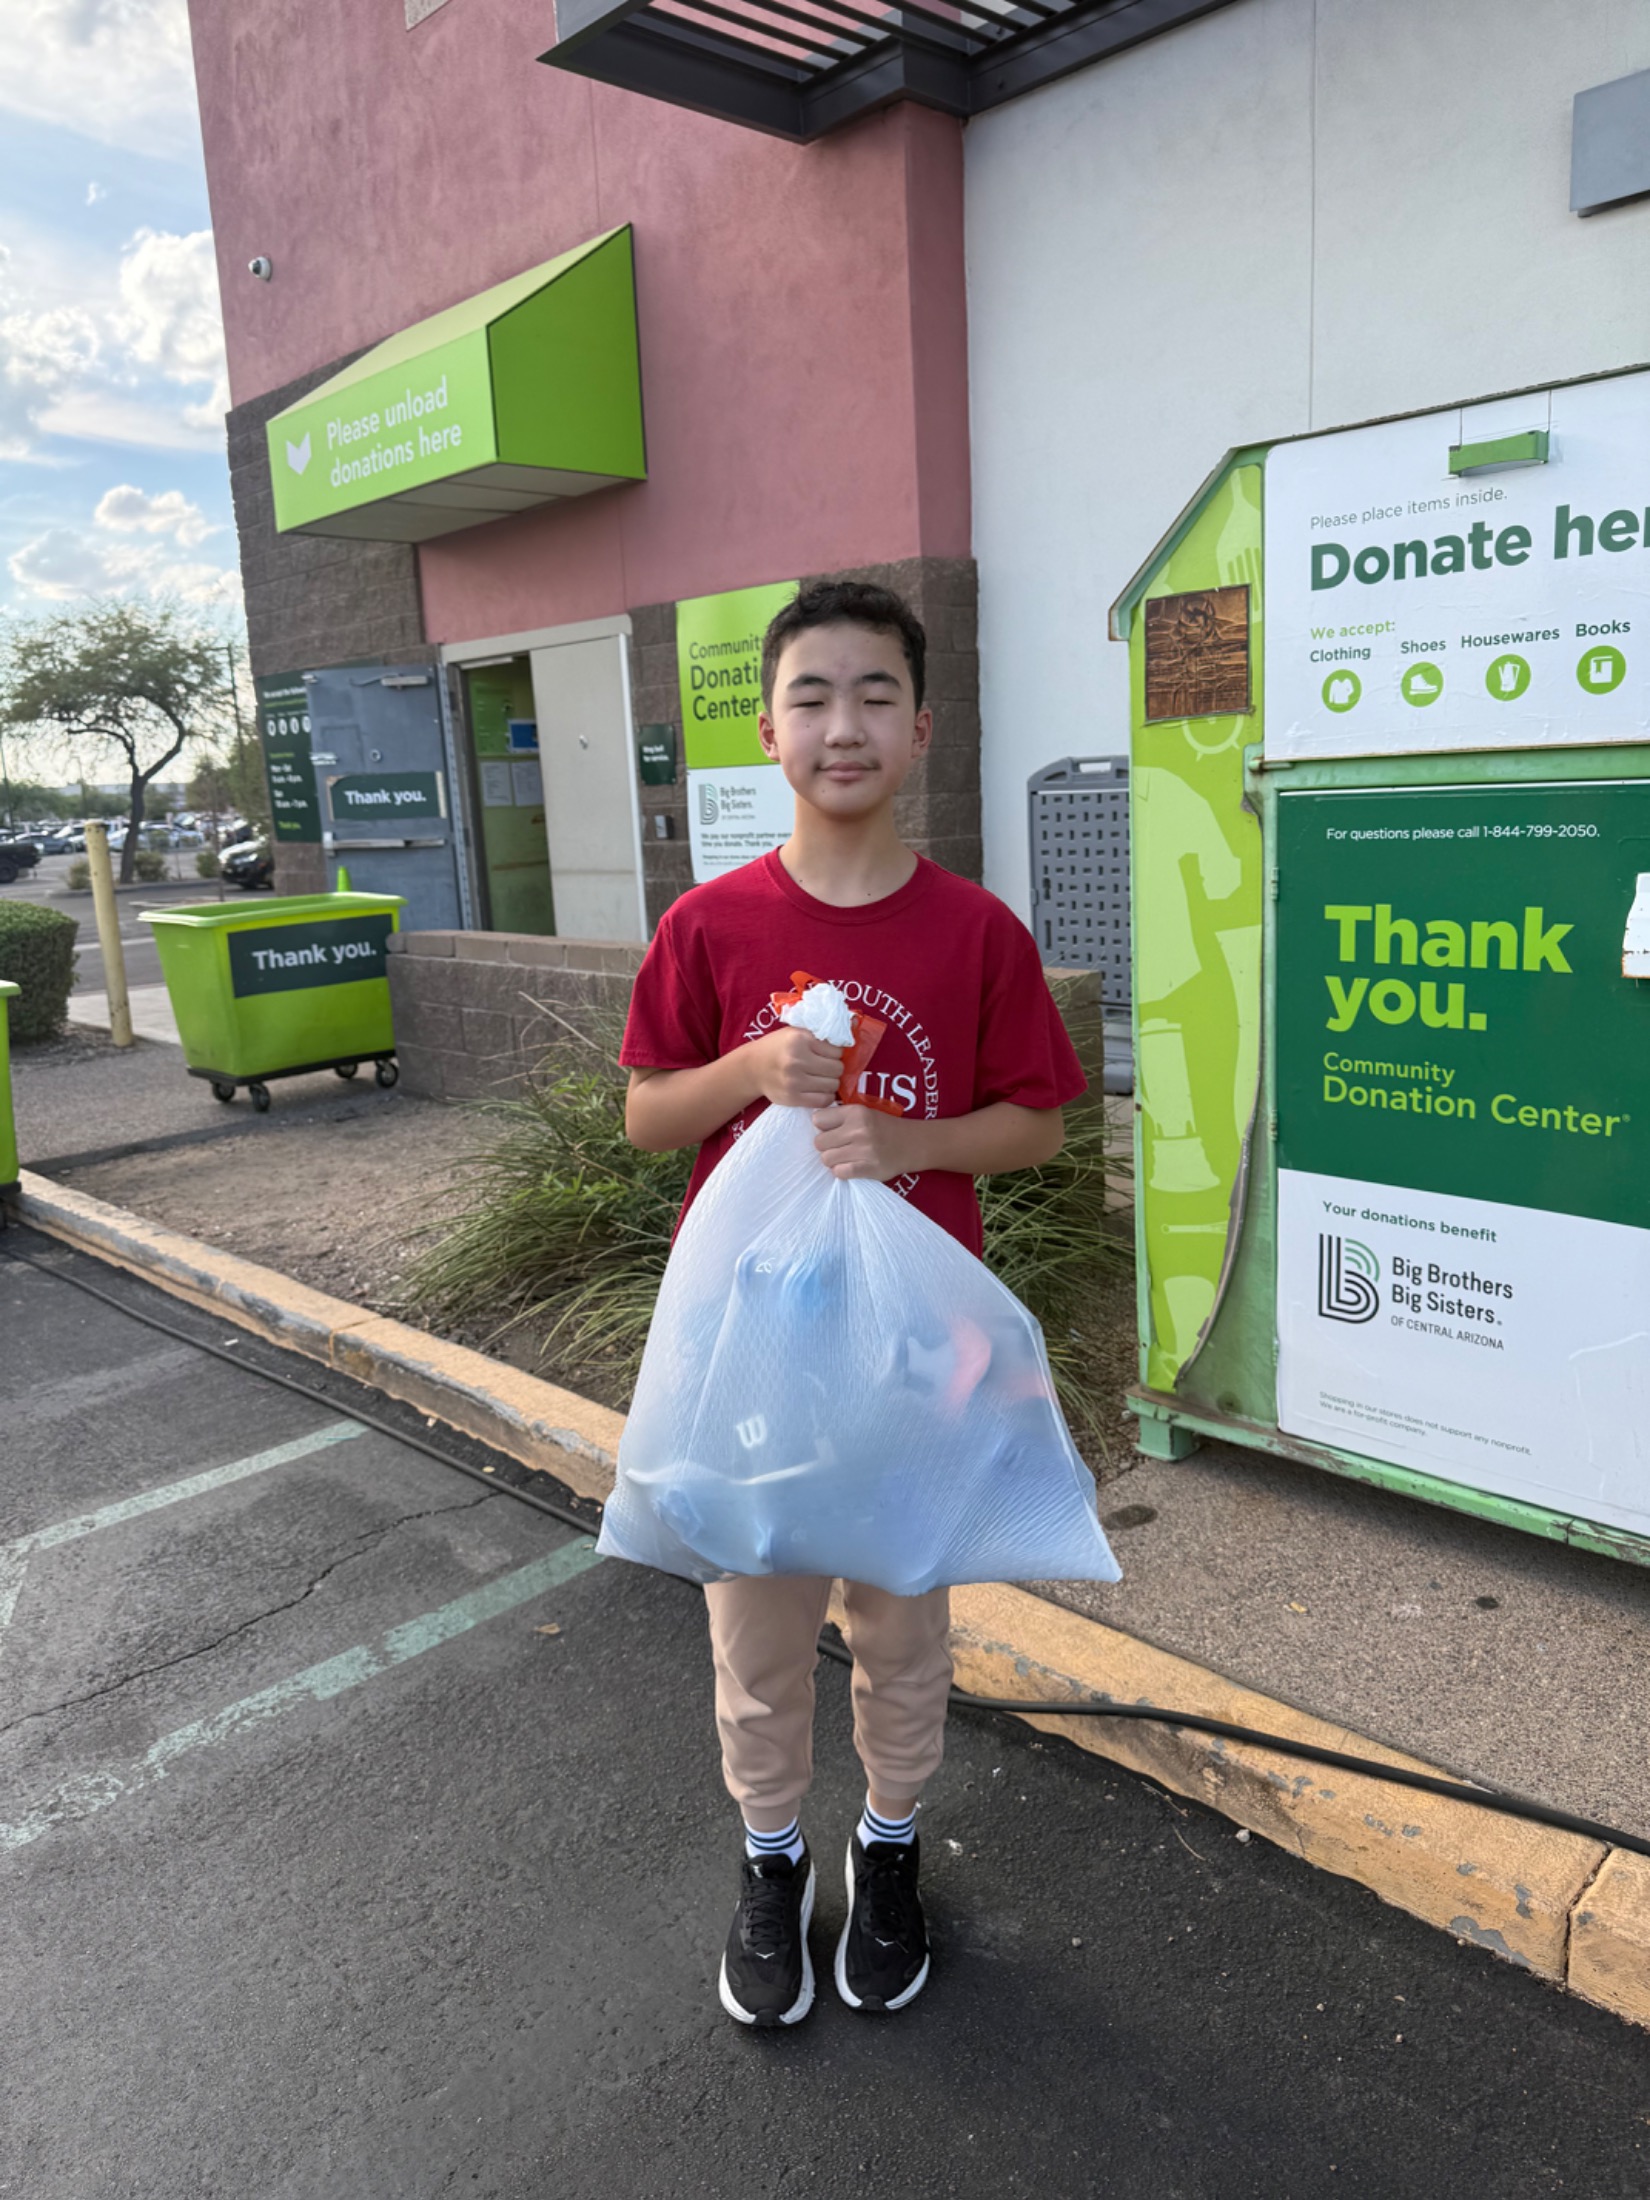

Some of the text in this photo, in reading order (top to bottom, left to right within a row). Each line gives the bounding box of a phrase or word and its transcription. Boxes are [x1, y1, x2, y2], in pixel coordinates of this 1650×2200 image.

[327, 374, 449, 451] Please unload
[330, 423, 462, 488] donations here
[1310, 486, 1508, 530] Please place items inside.
[1311, 503, 1650, 591] Donate he
[1310, 620, 1396, 640] We accept:
[1461, 628, 1560, 648] Housewares
[1575, 619, 1631, 637] Books
[688, 634, 763, 660] Communit
[1310, 646, 1371, 663] Clothing
[1400, 639, 1447, 655] Shoes
[690, 658, 759, 691] Donati
[693, 695, 760, 721] Center
[344, 790, 427, 805] Thank you.
[1326, 824, 1600, 841] For questions please call 1-844-799-2050.
[252, 942, 377, 970] Thank you.
[1324, 904, 1575, 974] Thank
[1324, 975, 1488, 1033] you.
[827, 979, 912, 1029] YOUTH
[906, 1024, 939, 1120] LEADER
[1323, 1052, 1455, 1088] Community
[1323, 1075, 1475, 1120] Donation
[1323, 1201, 1497, 1243] Your donations benefit
[1392, 1256, 1514, 1300] Big Brothers
[1391, 1284, 1422, 1314] Big
[1390, 1315, 1504, 1351] OF CENTRAL ARIZONA
[1319, 1400, 1333, 1411] We
[1334, 1405, 1346, 1414] are
[1319, 1391, 1355, 1408] Shopping
[1356, 1401, 1364, 1410] in
[1364, 1404, 1377, 1413] our
[1379, 1408, 1403, 1421] stores
[1404, 1415, 1424, 1426] does
[1425, 1420, 1439, 1431] not
[1440, 1425, 1472, 1440] support
[1474, 1434, 1489, 1445] any
